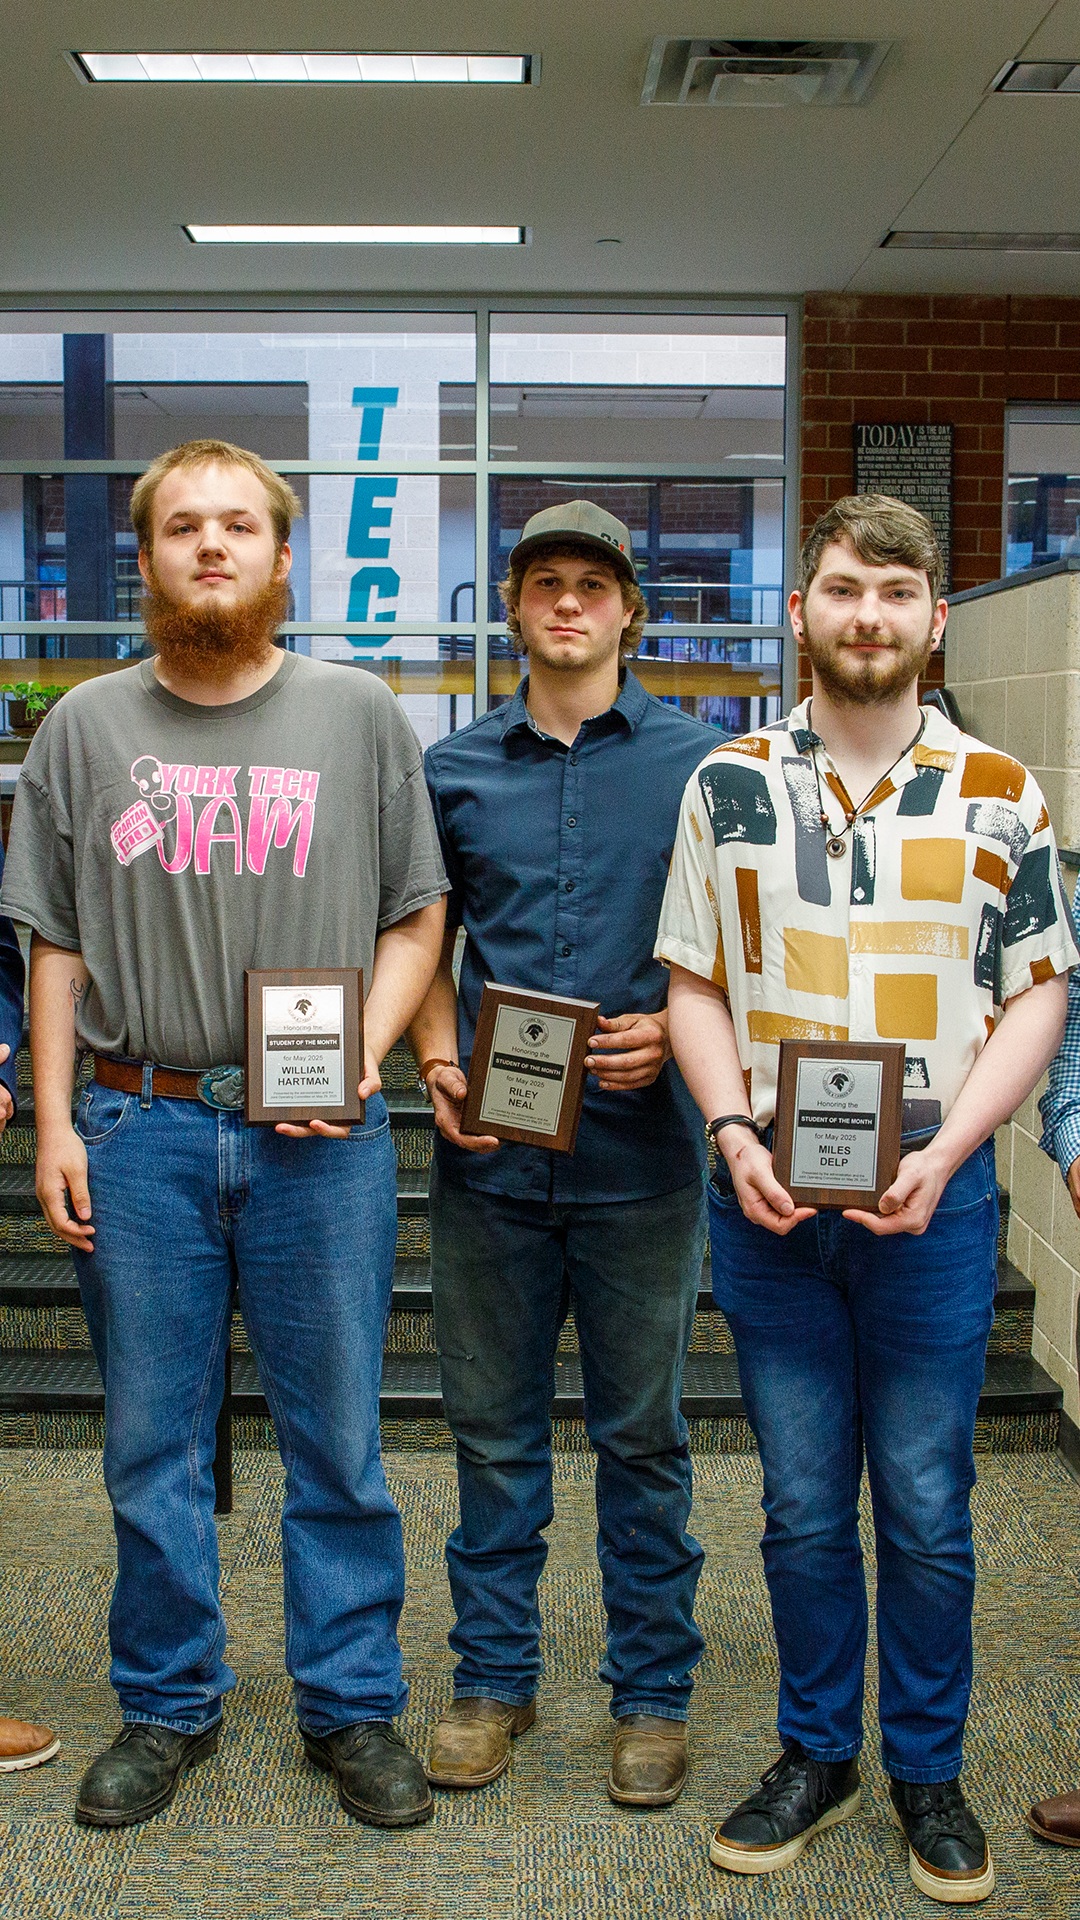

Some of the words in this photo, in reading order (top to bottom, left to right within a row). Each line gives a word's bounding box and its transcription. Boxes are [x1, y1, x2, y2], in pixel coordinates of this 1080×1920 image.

[858, 425, 917, 447] TODAY
[919, 426, 925, 434] IS
[926, 426, 937, 434] THE
[938, 426, 952, 434] DAY.
[858, 485, 866, 494] BE
[867, 485, 901, 494] GENEROUS
[902, 485, 916, 494] AND
[346, 387, 402, 660] TEC
[160, 764, 241, 797] YORK
[248, 766, 320, 802] TECH
[113, 806, 149, 842] SPARTAN
[156, 792, 315, 878] JAM
[512, 1046, 538, 1058] Honoring
[282, 1066, 325, 1074] WILLIAM
[495, 1058, 521, 1068] STUDENT
[529, 1064, 540, 1072] THE
[540, 1067, 561, 1076] MONTH
[278, 1077, 329, 1086] HARTMAN
[516, 1077, 528, 1086] May
[529, 1080, 545, 1088] 2025
[509, 1086, 538, 1099] RILEY
[508, 1098, 535, 1110] NEAL
[817, 1101, 847, 1109] Honoring
[818, 1145, 851, 1155] MILES
[820, 1157, 848, 1167] DELP
